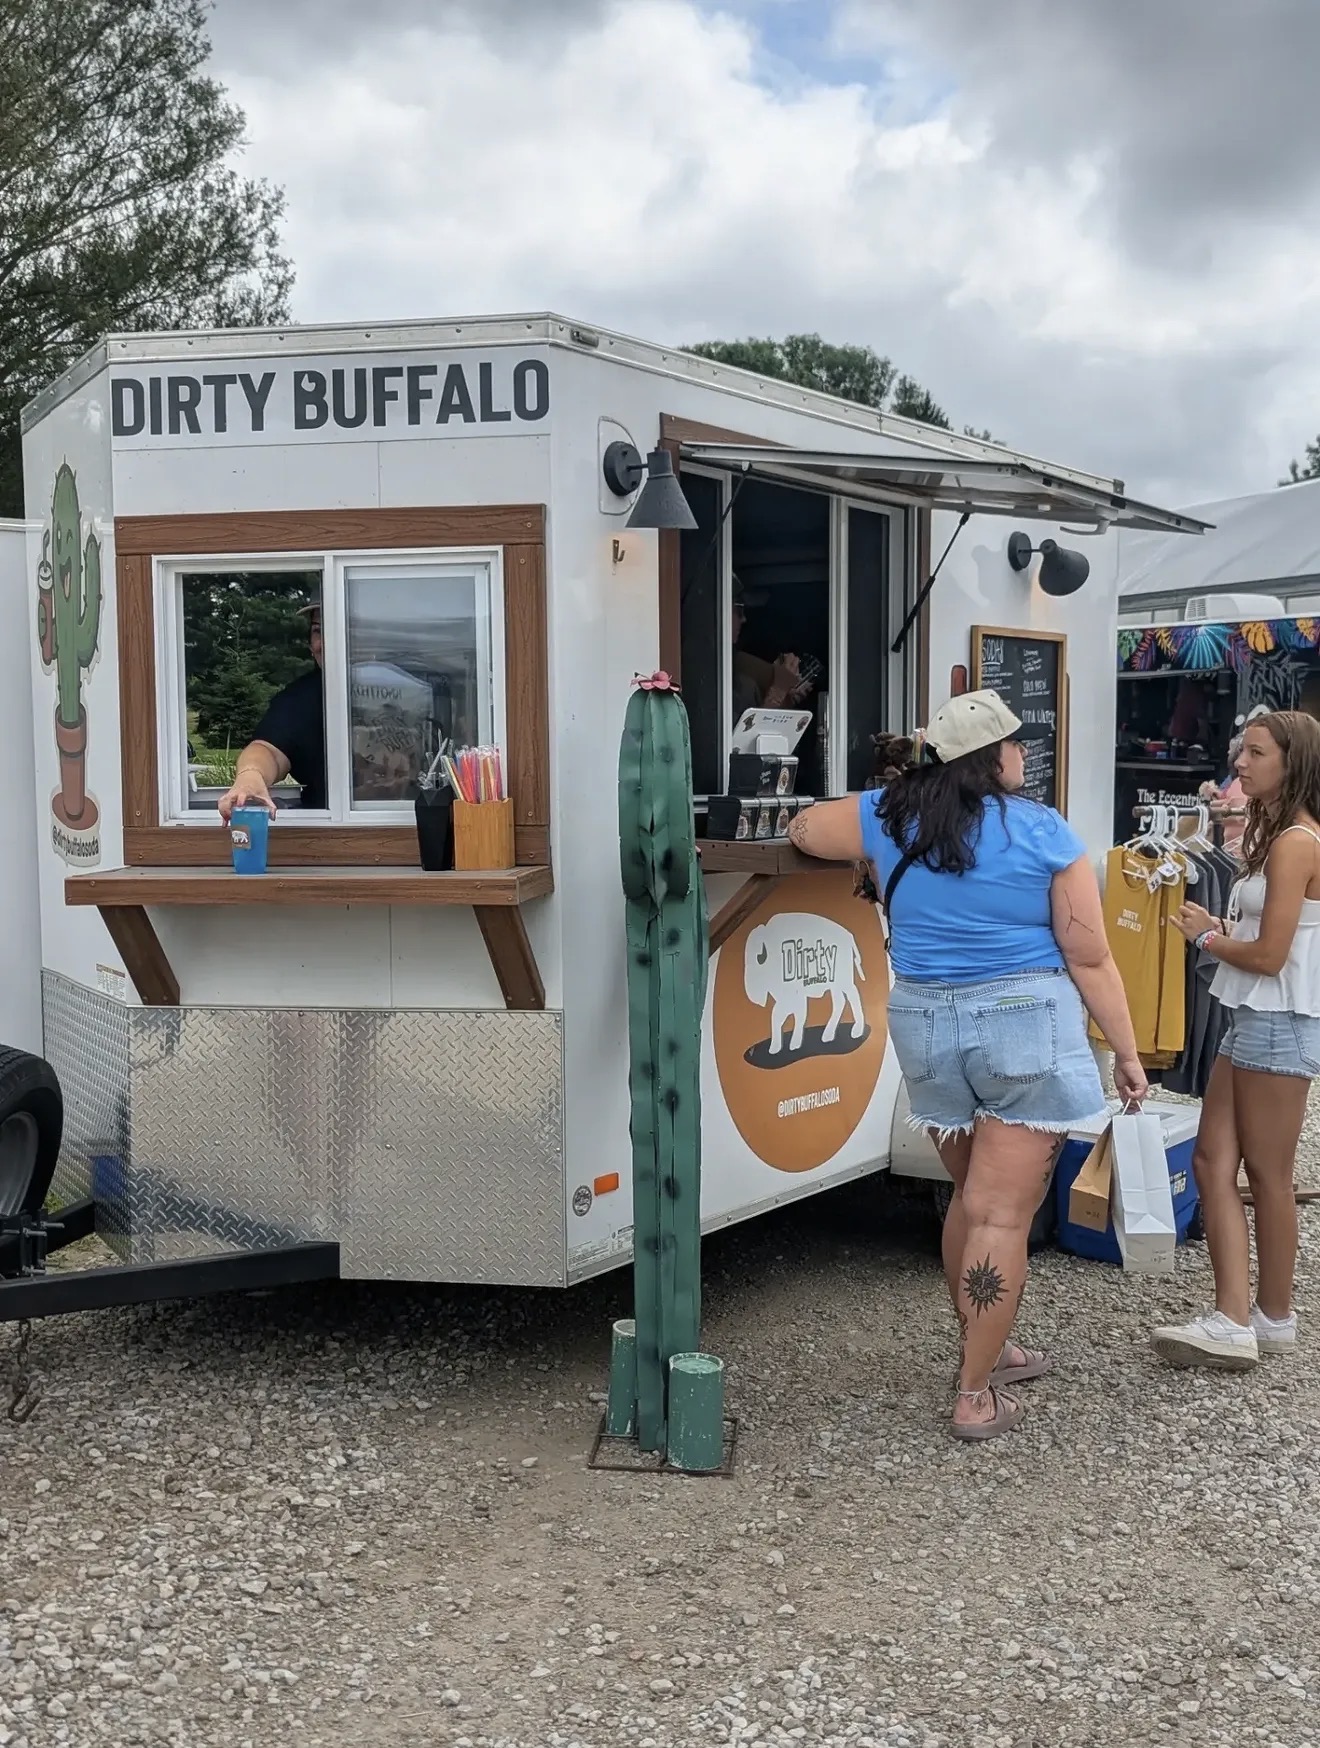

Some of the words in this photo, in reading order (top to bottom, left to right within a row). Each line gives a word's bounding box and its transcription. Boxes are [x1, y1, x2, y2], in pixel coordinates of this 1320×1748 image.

[111, 371, 276, 436] DIRTY
[293, 359, 550, 431] BUFFALO
[1136, 788, 1156, 803] The
[1122, 908, 1139, 921] DIRTY
[1116, 916, 1141, 932] BUFFALO
[781, 938, 838, 983] Dirty
[803, 975, 828, 987] BUFFALO
[777, 1086, 841, 1119] @DIRTYBUFFALOSODA
